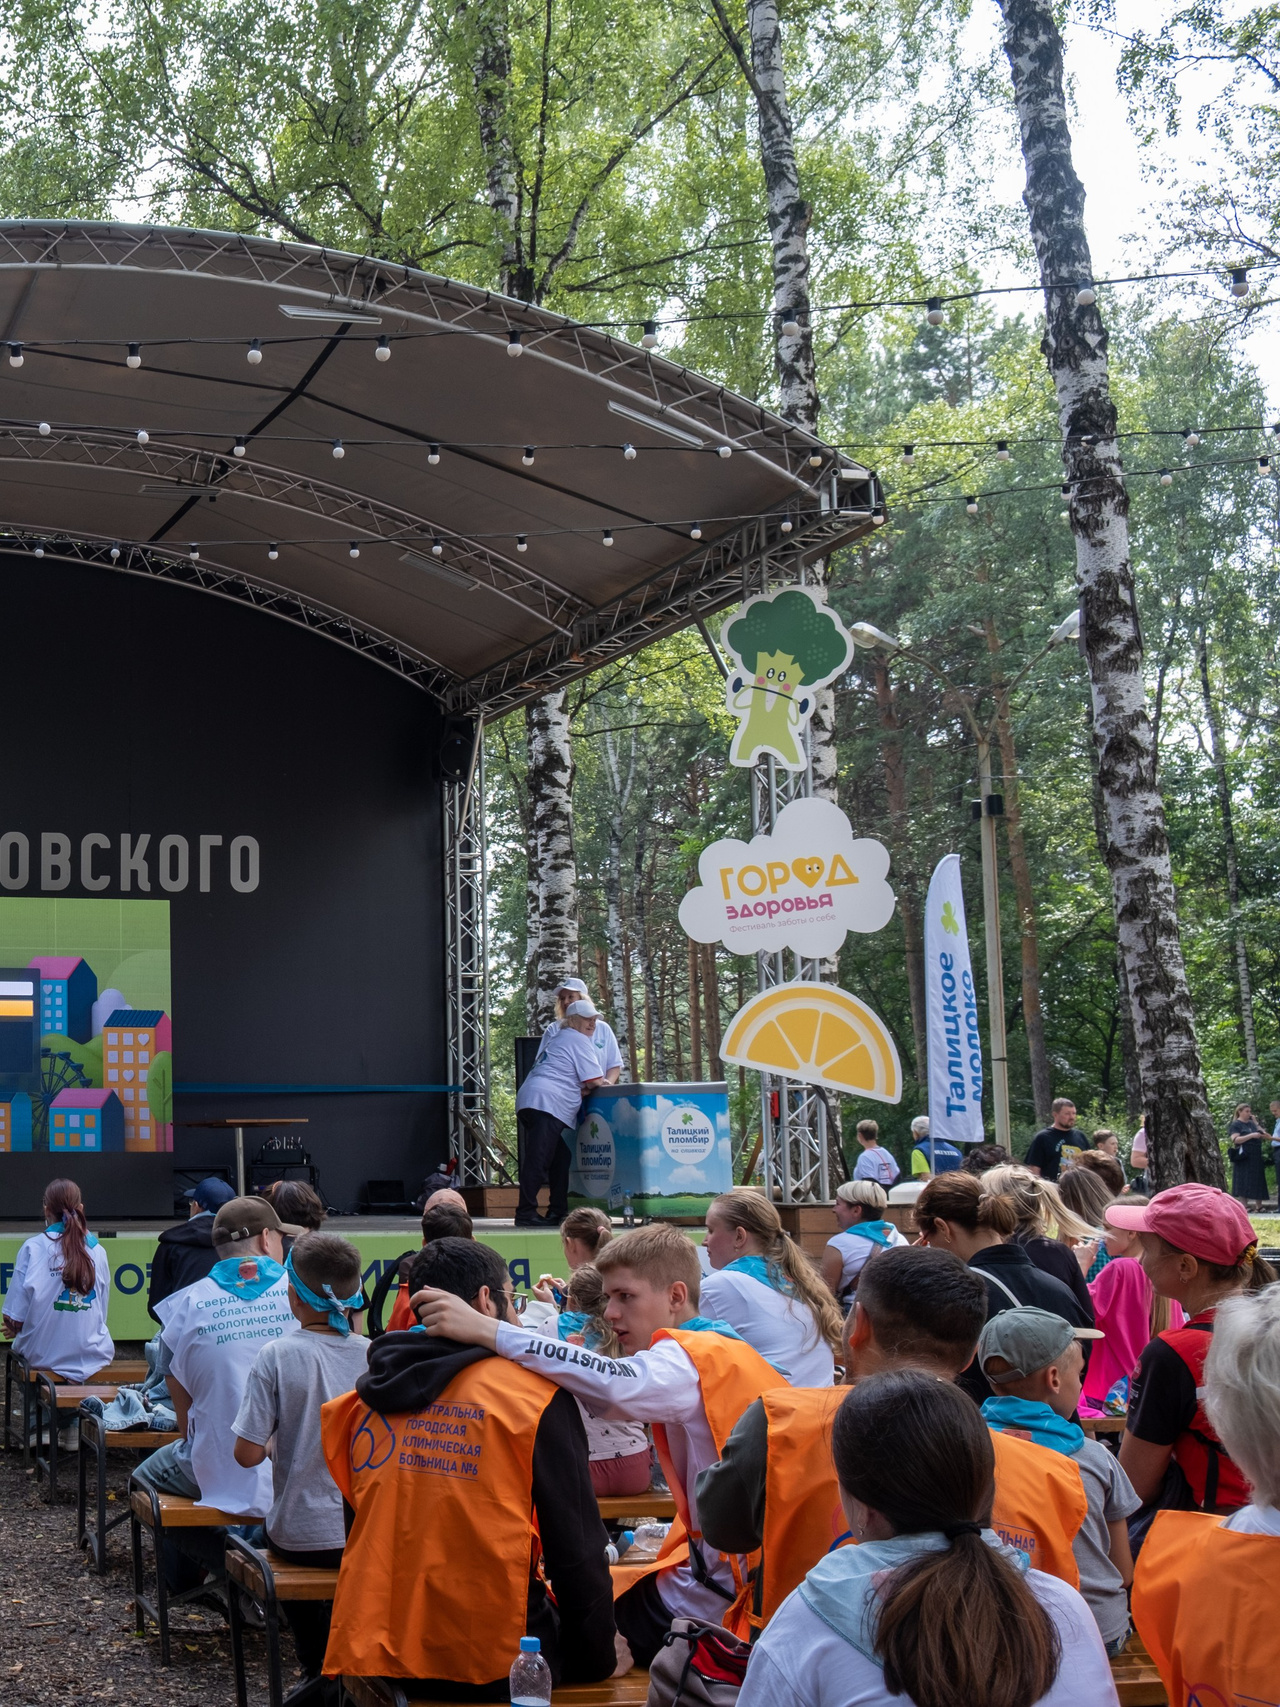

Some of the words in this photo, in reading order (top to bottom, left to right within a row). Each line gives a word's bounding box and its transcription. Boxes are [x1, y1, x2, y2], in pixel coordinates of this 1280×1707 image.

[729, 921, 776, 933] Фестиваль
[777, 917, 807, 927] заботы
[816, 913, 837, 922] себе
[939, 951, 967, 1118] Талицкое
[666, 1126, 709, 1136] Талицкий
[668, 1135, 710, 1145] пломбир
[579, 1141, 612, 1154] Талицкий
[581, 1154, 612, 1168] пломбир
[196, 1287, 289, 1310] Свердский
[212, 1301, 277, 1319] областной
[216, 1326, 283, 1345] диспансер
[525, 1340, 542, 1355] IT
[543, 1343, 568, 1361] DO
[569, 1350, 609, 1374] JUST
[416, 1403, 485, 1421] НТРАЛЬНАЯ
[405, 1418, 467, 1437] ГОРОДСКАЯ
[401, 1435, 482, 1458] КЛИНИЧЕСКАЯ
[398, 1452, 458, 1473] БОЛЬНИЦА
[460, 1461, 479, 1477] №6
